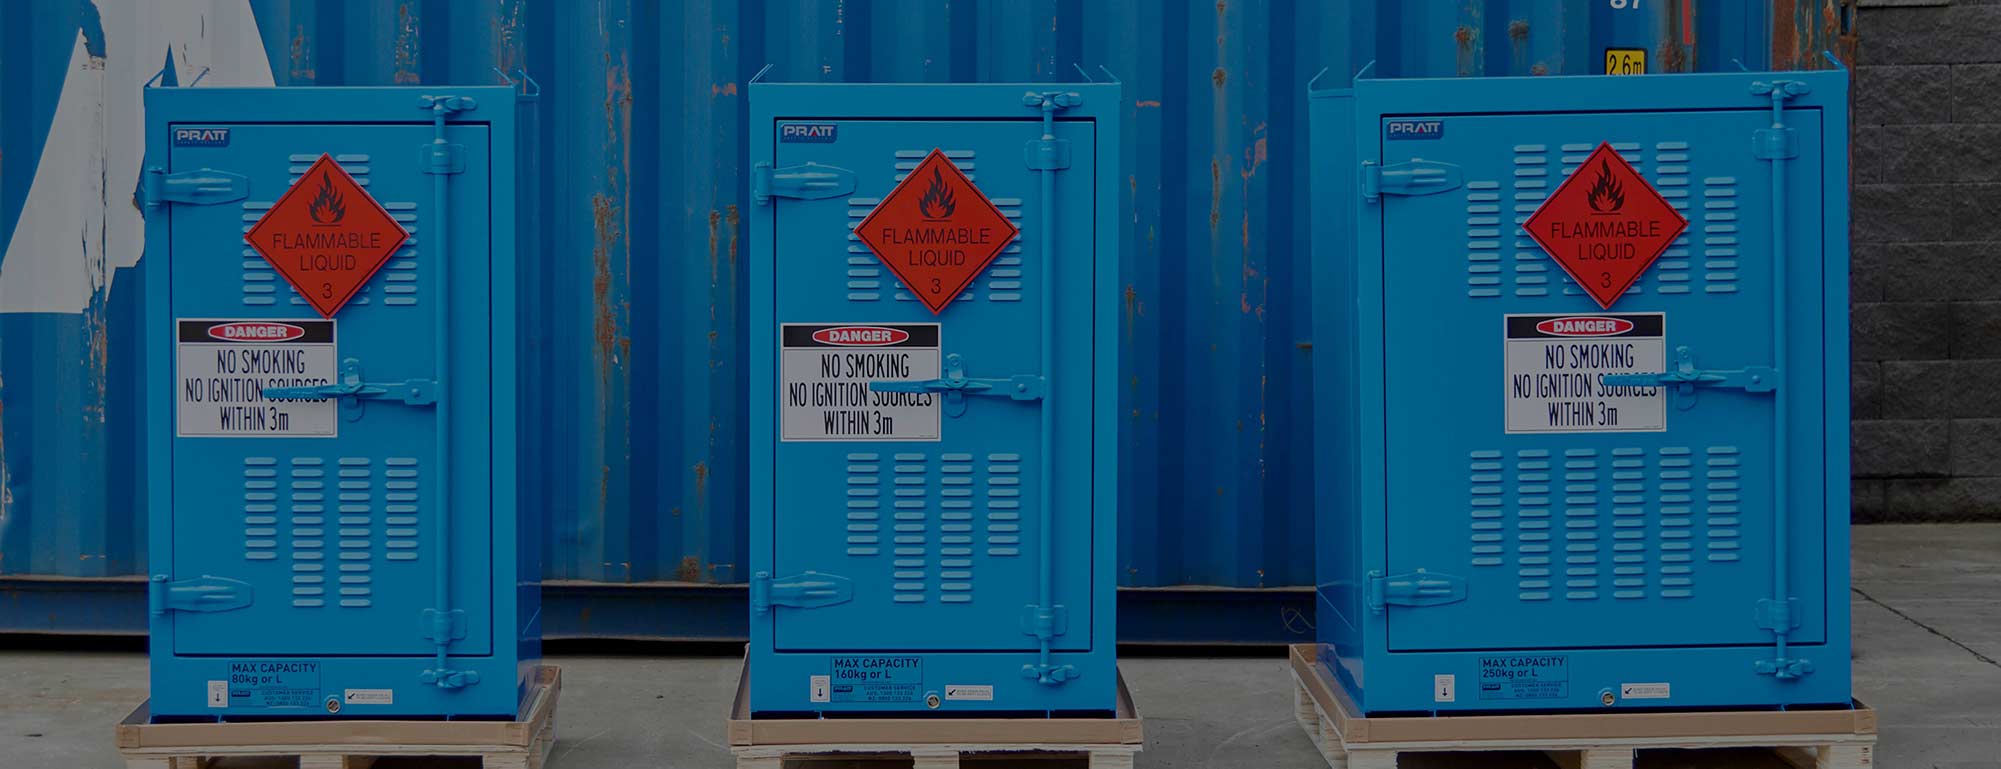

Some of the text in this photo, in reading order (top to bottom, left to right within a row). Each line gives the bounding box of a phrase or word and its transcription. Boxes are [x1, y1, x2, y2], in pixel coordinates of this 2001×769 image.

[1609, 54, 1642, 75] 26m
[177, 130, 228, 140] PRATT
[784, 126, 835, 136] PRATT
[1390, 123, 1441, 133] PRATT
[882, 228, 991, 245] FLAMMABLE
[1551, 221, 1661, 238] FLAMMABLE
[272, 232, 381, 249] FLAMMABLE
[908, 250, 966, 267] LIQUID
[1578, 243, 1636, 261] LIQUID
[299, 254, 356, 272] LIQUID
[930, 278, 941, 295] 3
[1600, 272, 1611, 289] 3
[322, 283, 333, 299] 3
[224, 325, 288, 339] DANGER
[1553, 320, 1617, 334] DANGER
[828, 330, 892, 343] DANGER
[217, 349, 305, 374] NO SMOKING
[1545, 344, 1634, 369] NO SMOKING
[821, 354, 909, 378] NO SMOKING
[186, 378, 203, 402] NO
[208, 378, 264, 402] IGNITION
[789, 382, 807, 407] NO
[812, 382, 868, 407] IGNITION
[1513, 374, 1531, 399] NO
[1536, 373, 1592, 398] IGNITION
[220, 406, 289, 431] WITHIN 3m
[823, 410, 893, 435] WITHIN 3m
[1548, 401, 1618, 427] WITHIN 3m
[232, 663, 316, 673] MAX CAPACITY
[834, 658, 919, 668] MAX CAPACITY
[1482, 657, 1564, 668] MAX CAPACITY
[232, 674, 258, 686] 80kg
[276, 674, 283, 683] L
[835, 669, 892, 680] 160kg or L
[1482, 668, 1514, 679] 250kg
[1532, 668, 1539, 677] L
